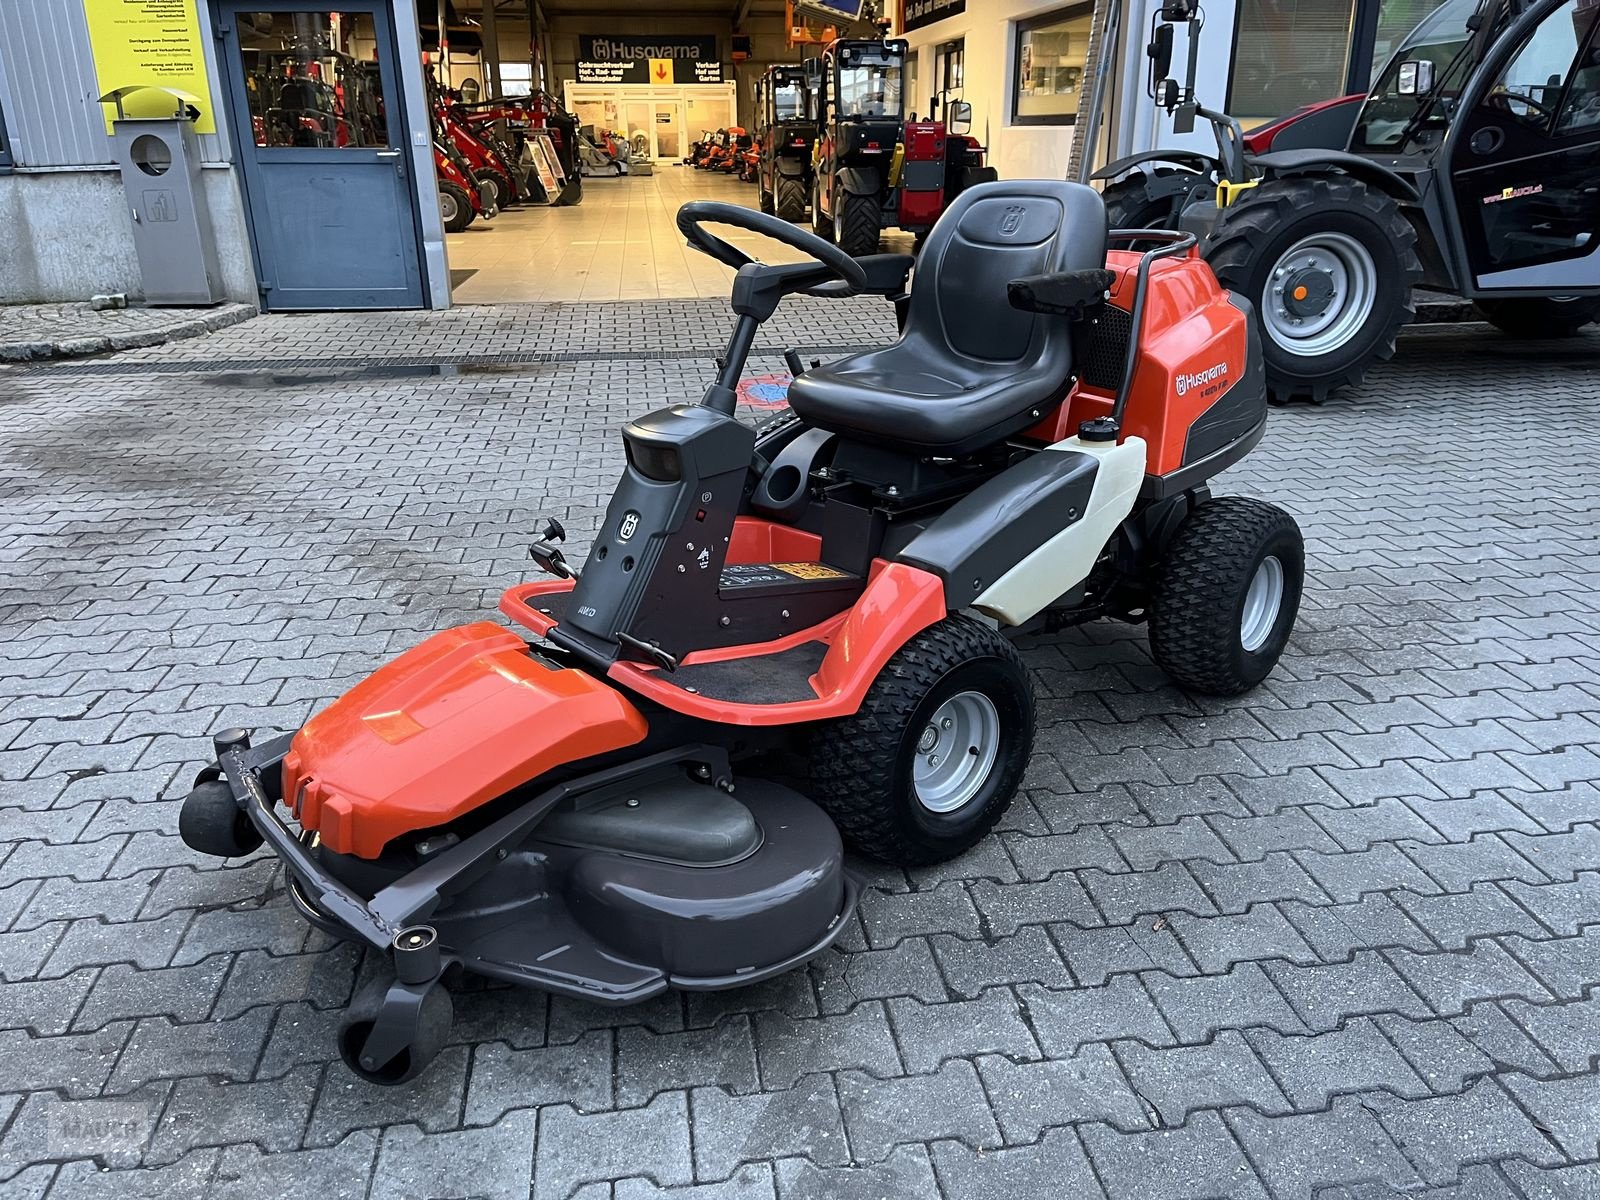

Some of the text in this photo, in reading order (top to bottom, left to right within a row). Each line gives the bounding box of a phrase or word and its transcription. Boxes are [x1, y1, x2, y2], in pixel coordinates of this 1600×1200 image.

[612, 42, 700, 60] Husqvarna
[1186, 362, 1227, 390] Husqvarna
[578, 606, 596, 617] AWD
